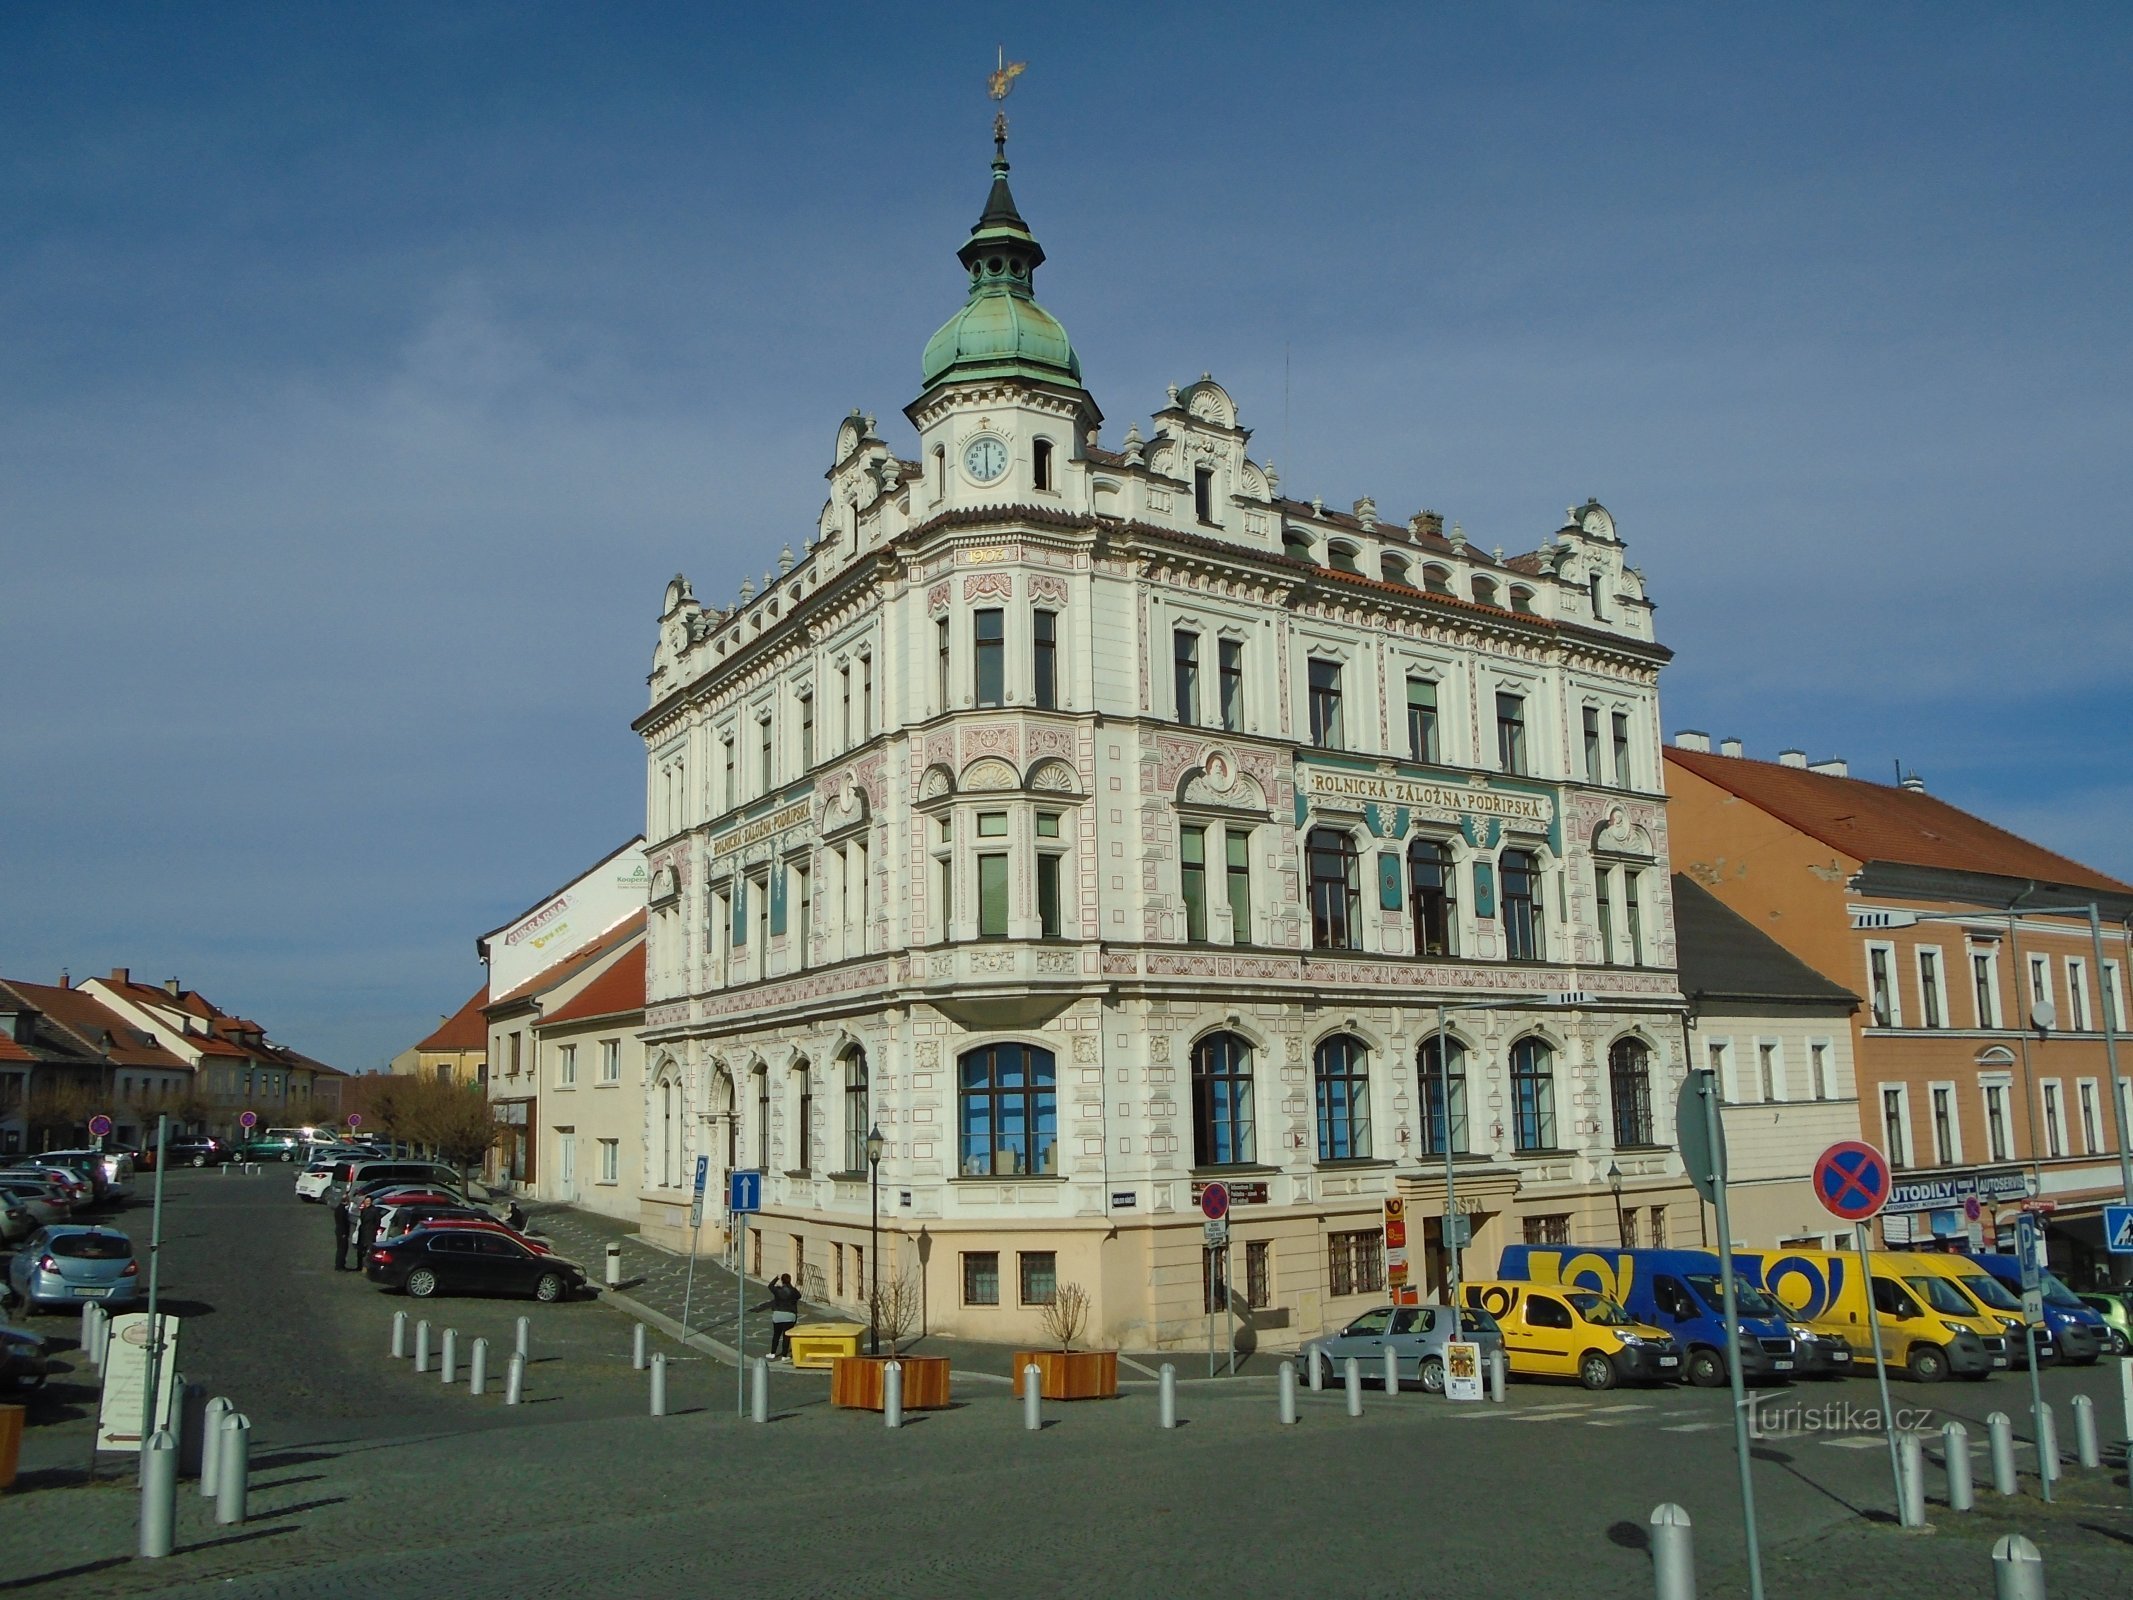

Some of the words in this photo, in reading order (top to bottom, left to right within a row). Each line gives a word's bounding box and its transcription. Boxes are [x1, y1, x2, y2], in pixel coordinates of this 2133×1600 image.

[1315, 775, 1388, 798] ROLNICKÁ
[1396, 784, 1461, 808] ZÁLOŽNA
[1467, 794, 1540, 817] PODŘIPSKÁ
[508, 900, 568, 946] CUKRÁRNA
[697, 1160, 706, 1181] P
[1888, 1181, 1953, 1202] UTODÍLY
[1980, 1175, 2025, 1193] AUTOSERVIS
[1884, 1203, 1920, 1214] UTOSPORT
[2021, 1223, 2031, 1265] P
